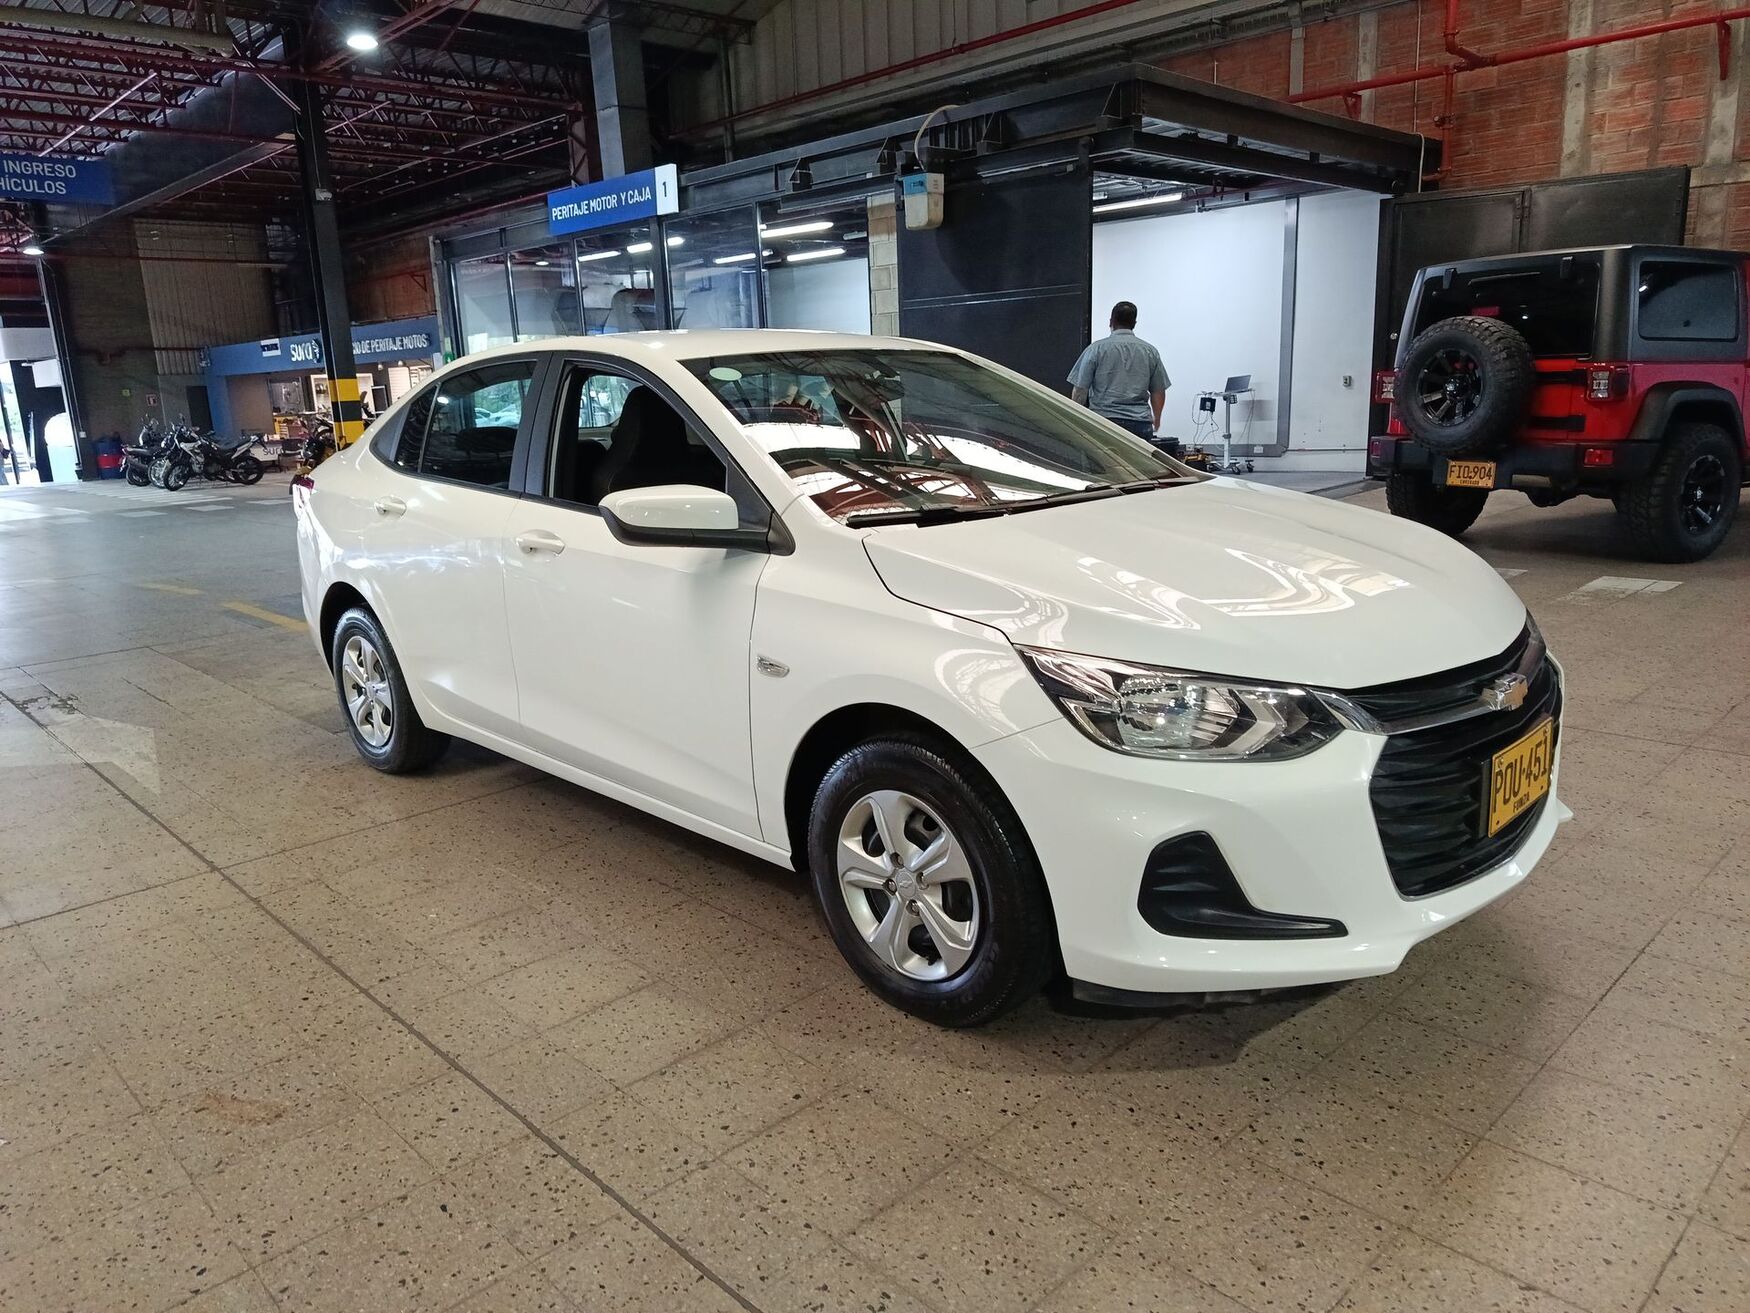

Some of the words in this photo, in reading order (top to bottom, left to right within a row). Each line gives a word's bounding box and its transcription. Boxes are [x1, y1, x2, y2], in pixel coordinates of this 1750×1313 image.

[3, 160, 76, 178] INGRESO
[662, 181, 667, 198] 1
[552, 201, 589, 221] PERITAJE
[590, 194, 618, 213] MOTOR
[620, 191, 626, 206] Y
[628, 186, 652, 204] CAJA
[361, 340, 370, 353] DE
[370, 336, 403, 352] PERITAJE
[402, 334, 428, 350] MOTOS
